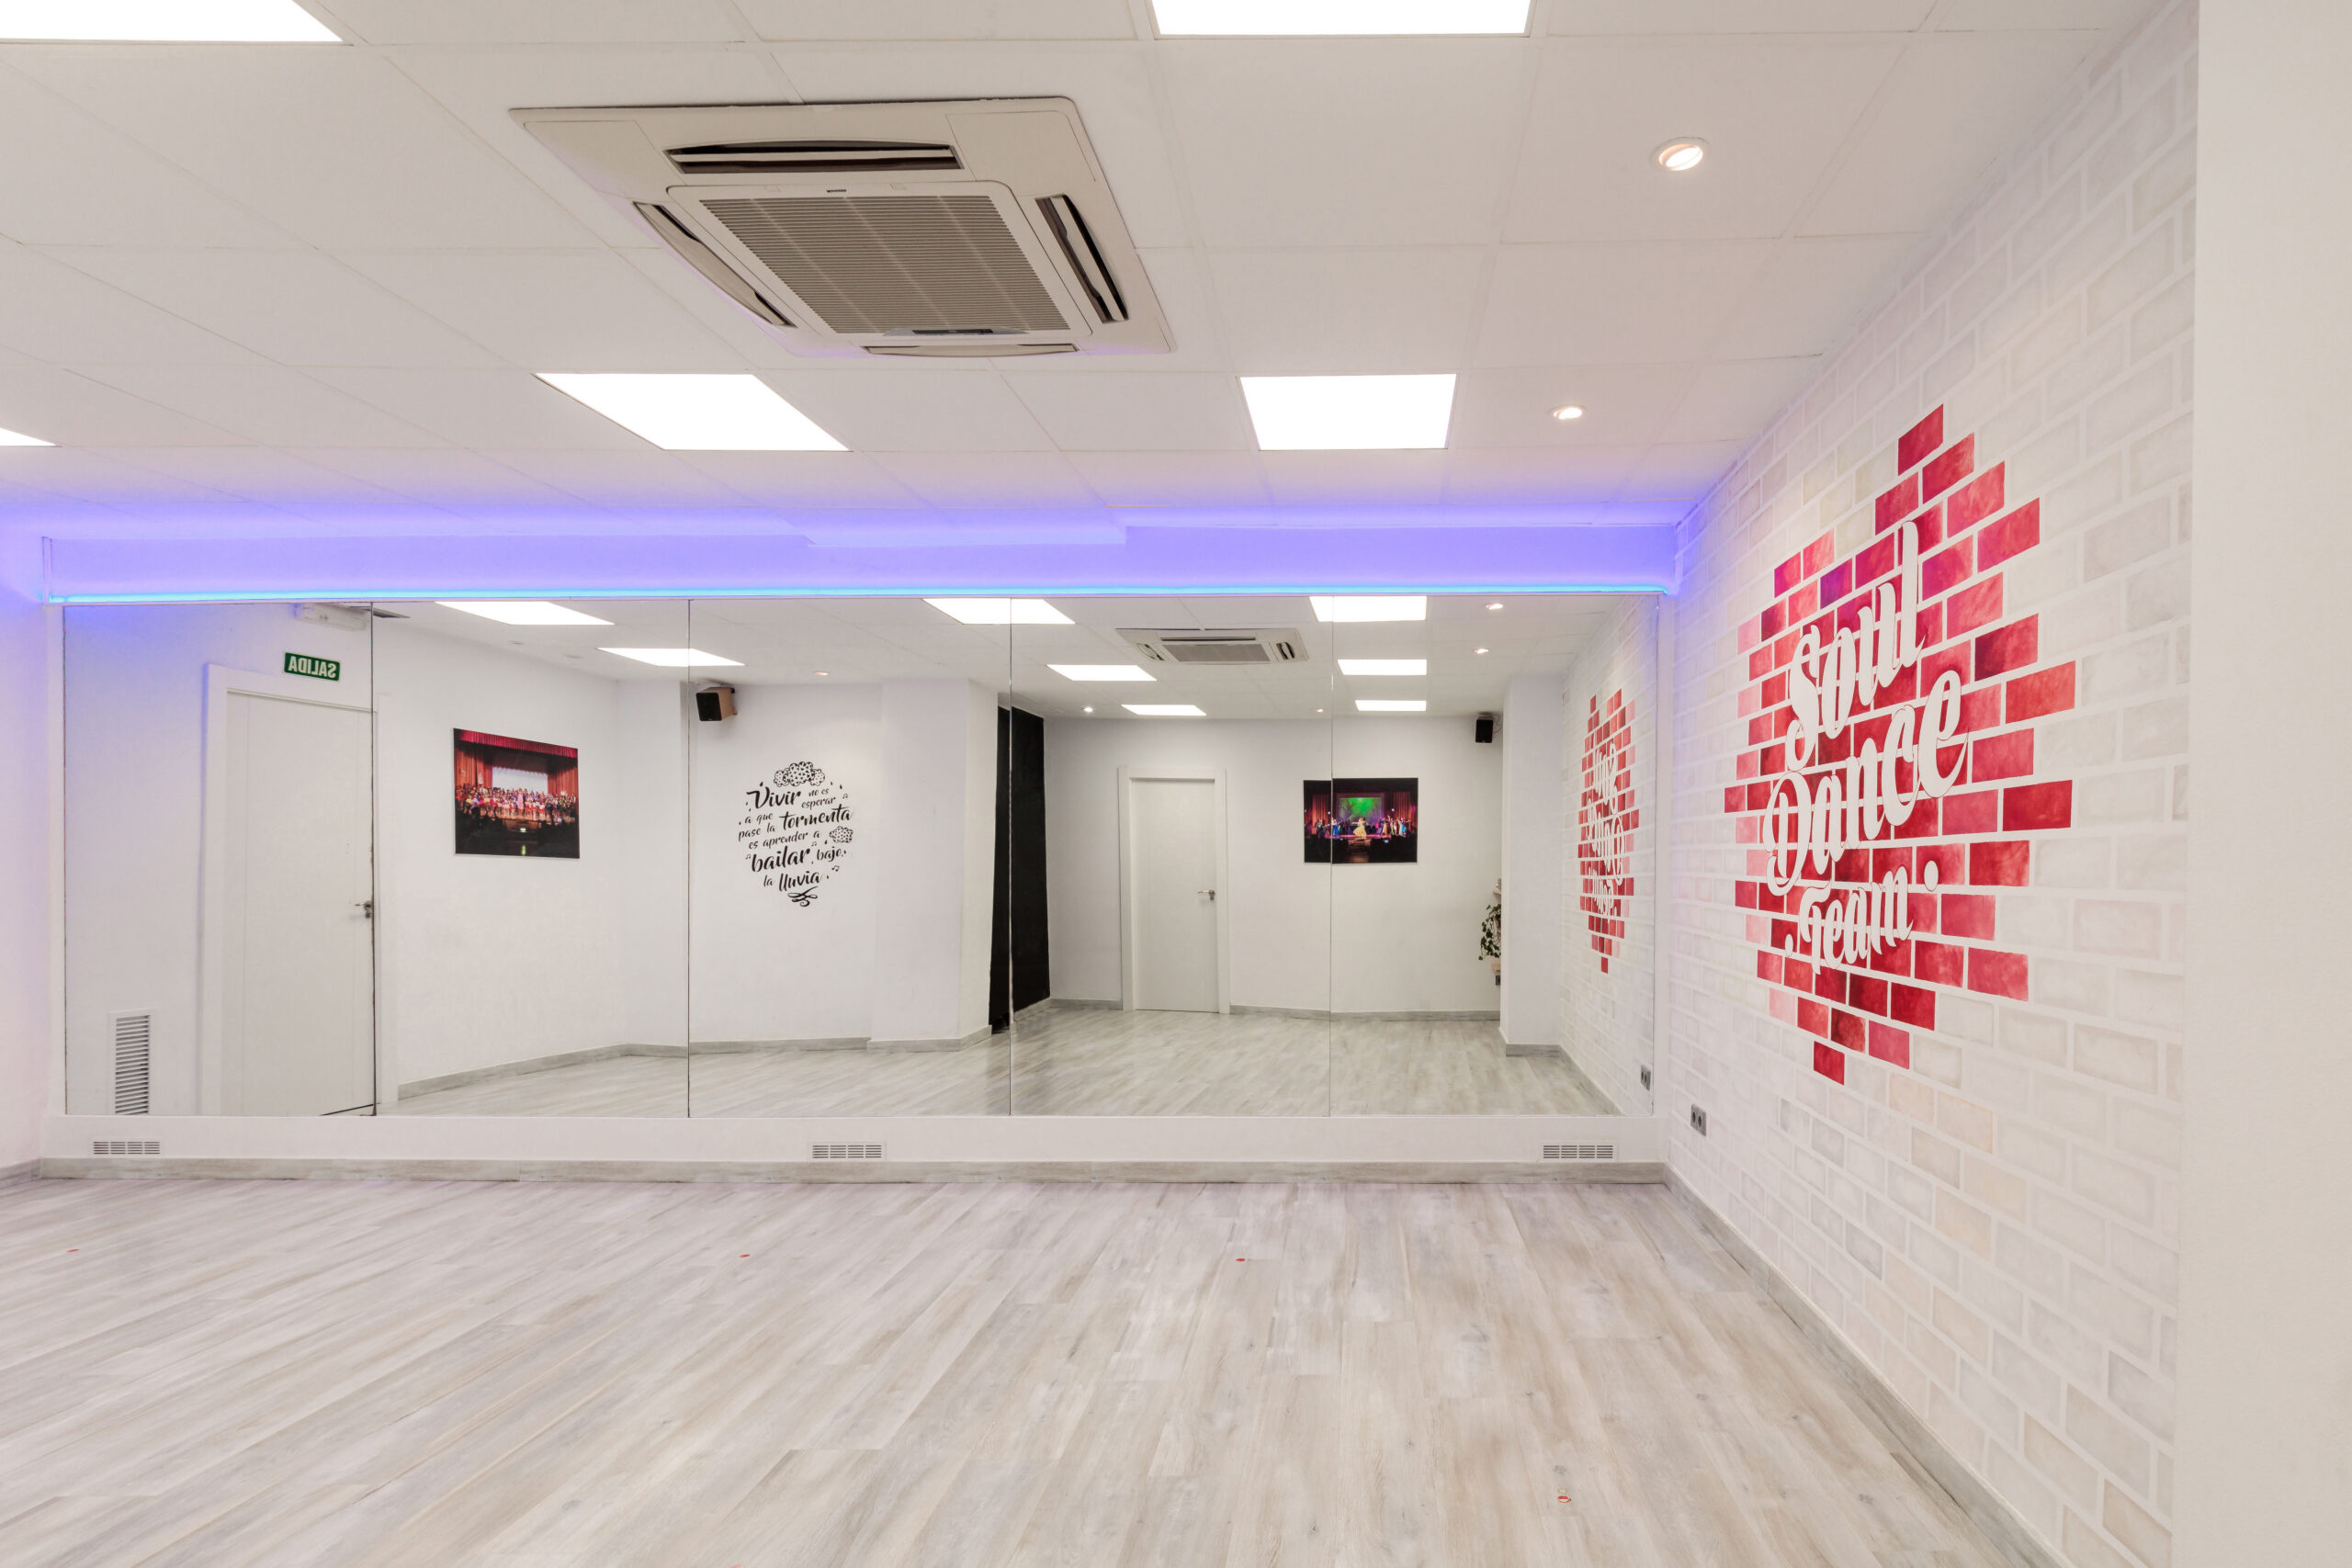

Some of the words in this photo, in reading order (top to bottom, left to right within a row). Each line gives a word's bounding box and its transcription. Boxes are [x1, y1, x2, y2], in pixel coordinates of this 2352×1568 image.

[1784, 520, 1926, 772] Soul
[1762, 670, 1969, 897] Dance
[746, 786, 801, 808] Vivir
[801, 796, 836, 810] esperar
[744, 816, 752, 824] a
[756, 812, 773, 825] que
[779, 804, 853, 830] tormenta
[738, 827, 761, 842] pase
[766, 822, 776, 833] la
[748, 840, 759, 850] es
[763, 830, 808, 849] aprender
[813, 830, 820, 839] a
[751, 845, 810, 872] bailar
[816, 846, 842, 862] bajo
[763, 874, 775, 887] la
[778, 871, 823, 892] lluvia
[1800, 865, 1914, 975] Team
